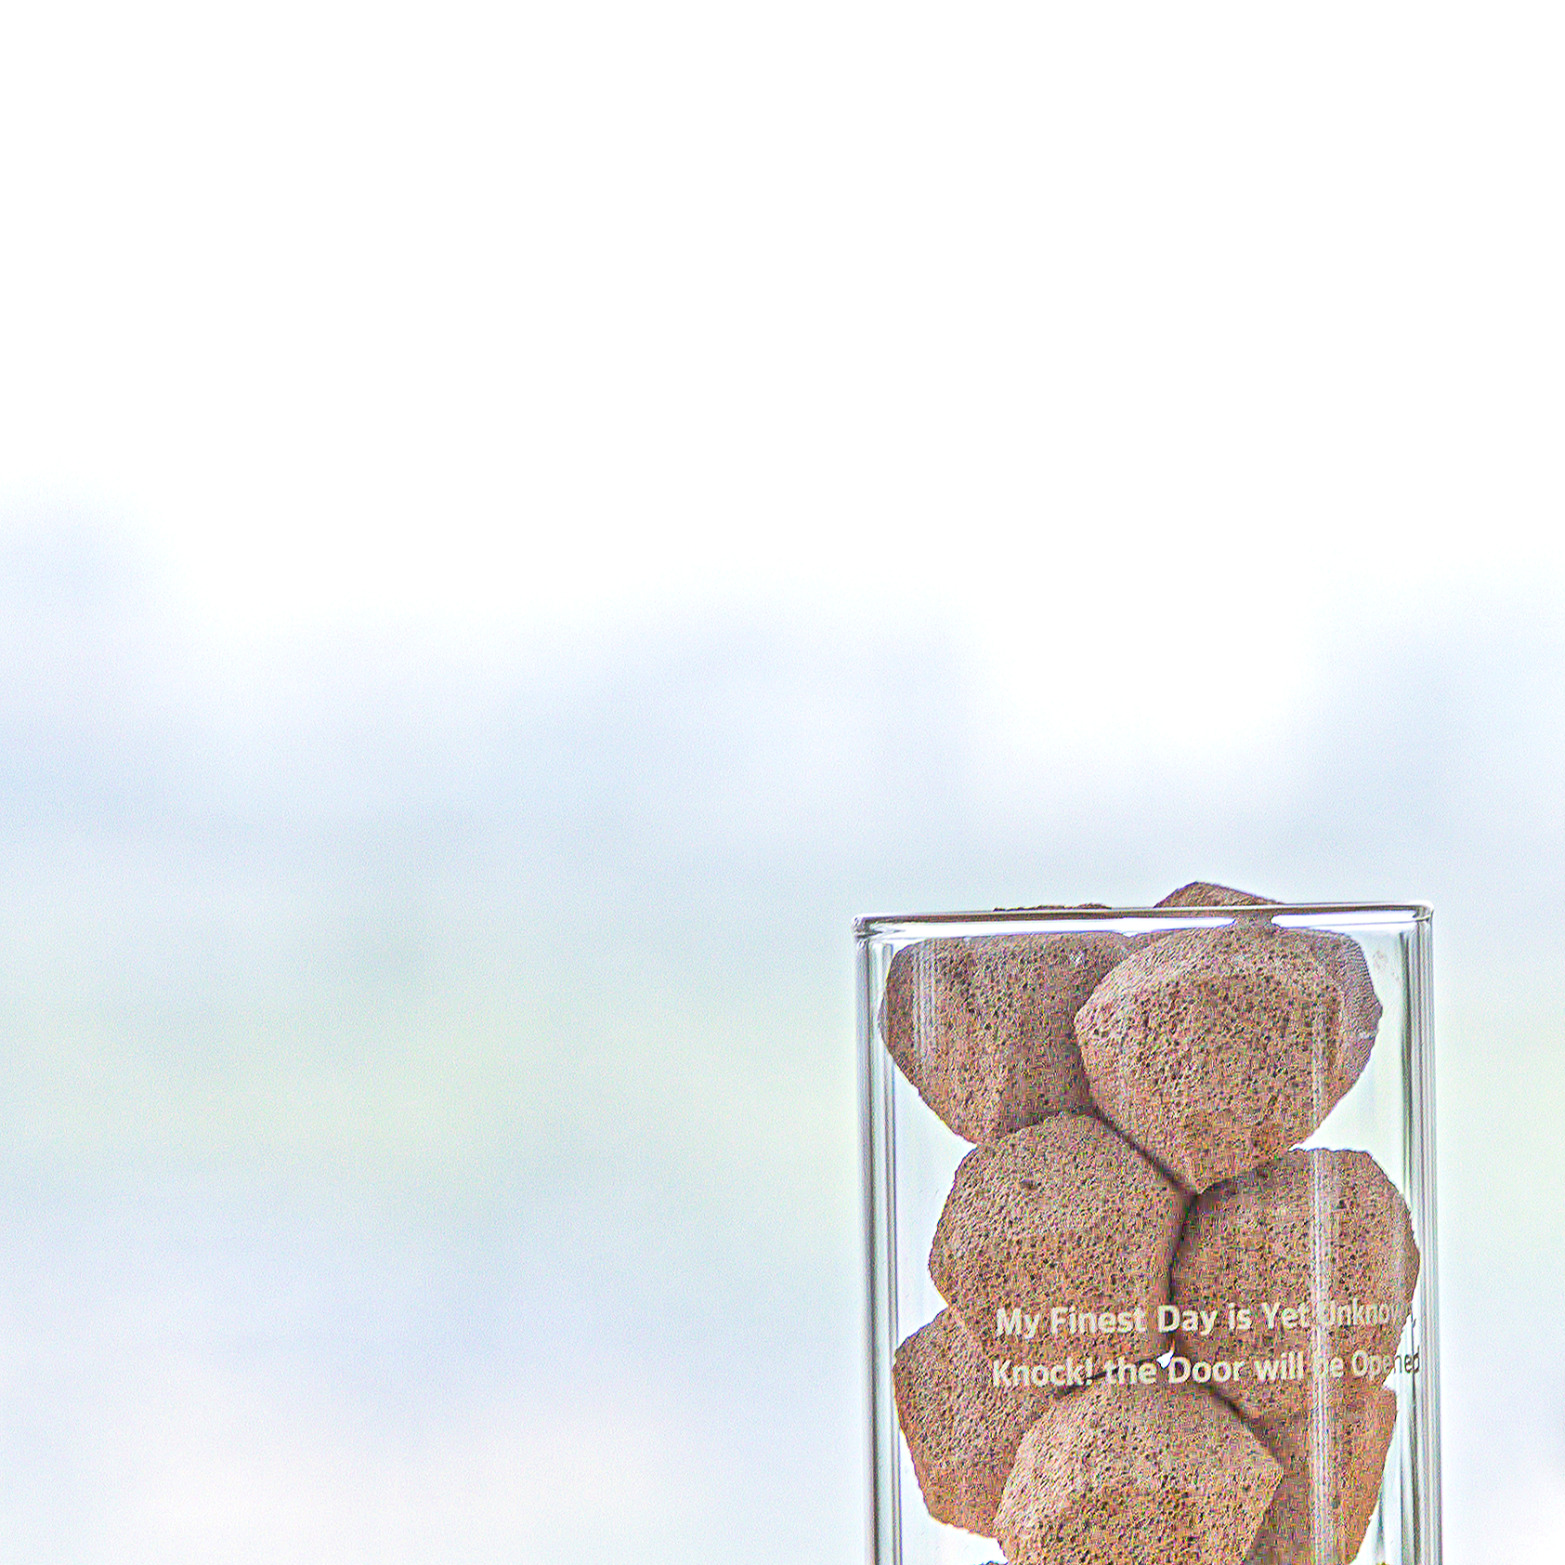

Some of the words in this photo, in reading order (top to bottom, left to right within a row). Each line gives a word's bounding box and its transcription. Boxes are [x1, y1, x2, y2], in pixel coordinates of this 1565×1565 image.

[996, 1308, 1039, 1340] My
[1050, 1305, 1147, 1335] Finest
[1157, 1304, 1217, 1337] Day
[1229, 1302, 1252, 1331] is
[1261, 1301, 1309, 1331] Yet
[992, 1357, 1096, 1389] Knock!
[1104, 1355, 1157, 1386] the
[1167, 1355, 1245, 1385] Door
[1253, 1351, 1304, 1382] will
